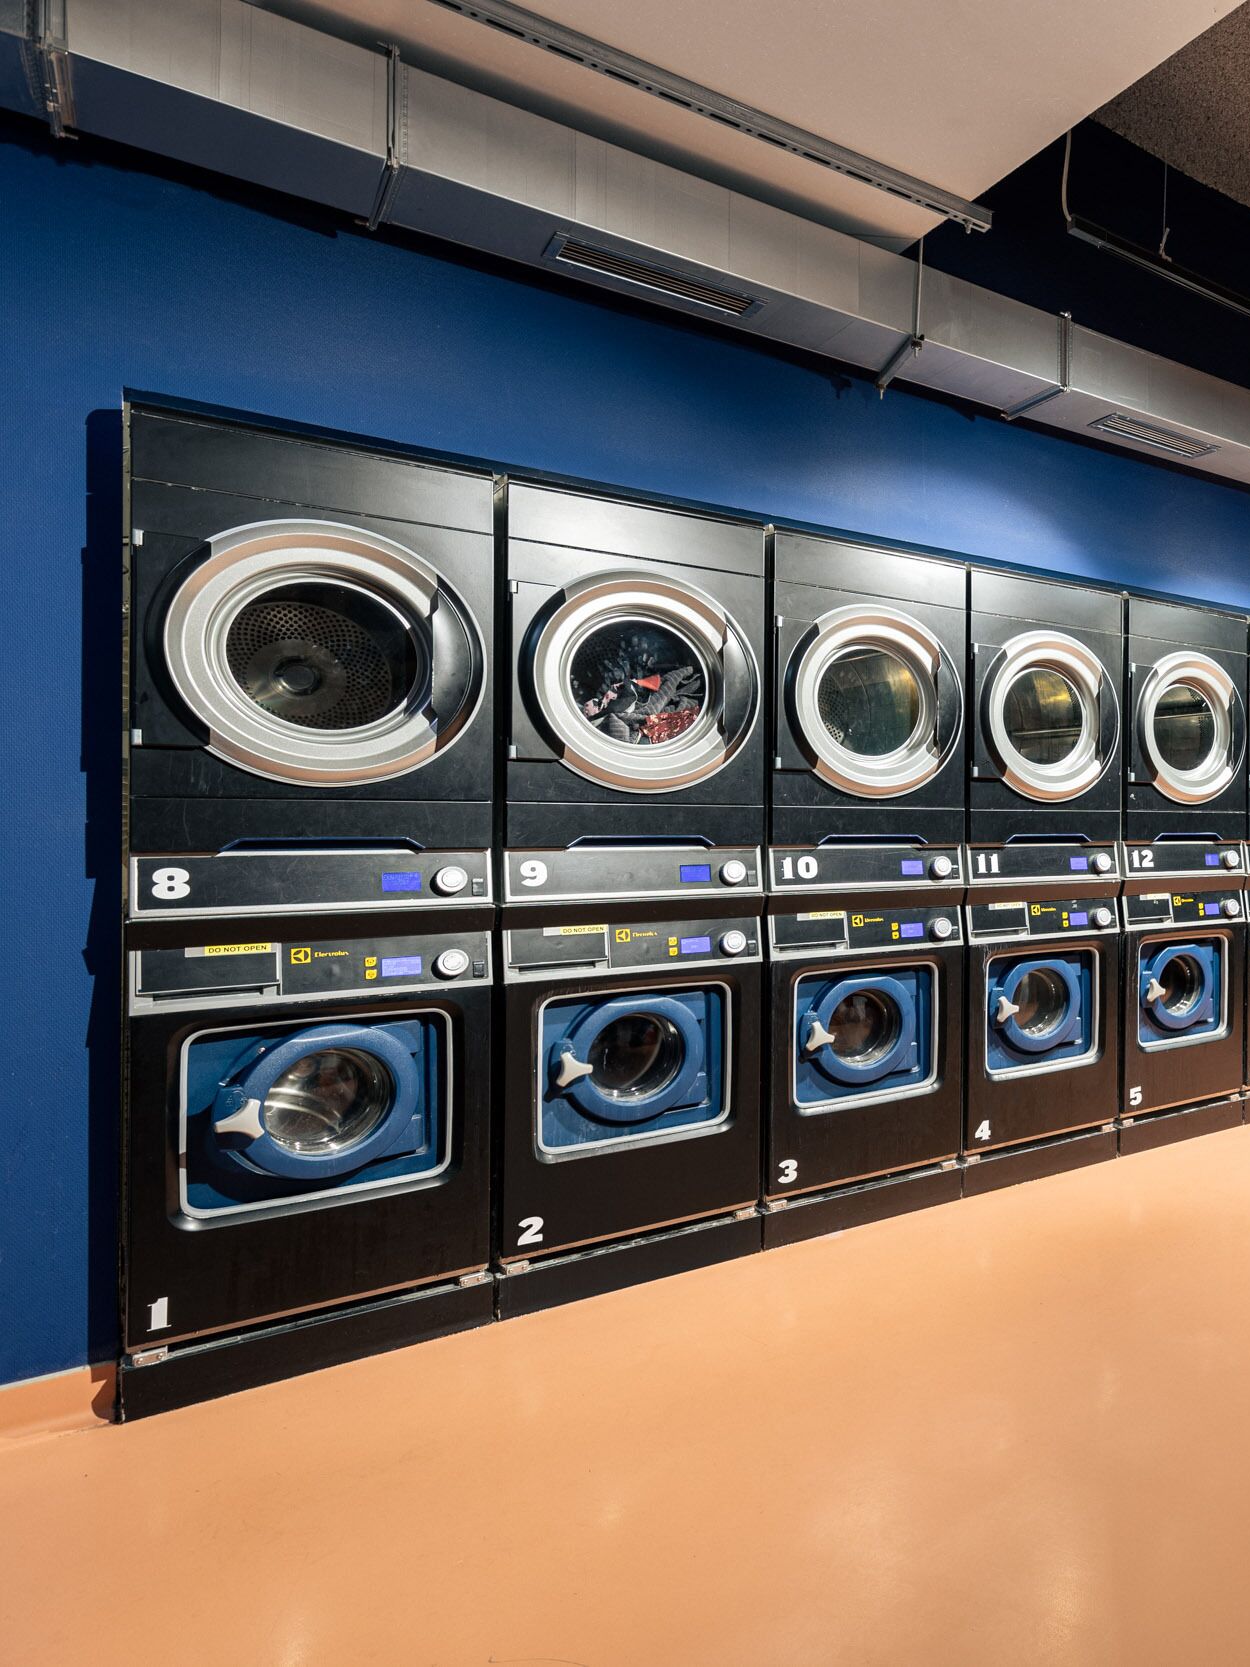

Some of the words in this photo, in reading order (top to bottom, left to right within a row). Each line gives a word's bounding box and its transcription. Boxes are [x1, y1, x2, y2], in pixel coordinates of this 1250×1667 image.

[780, 855, 818, 880] 10
[976, 853, 1001, 874] 11
[1131, 849, 1155, 868] 12
[151, 867, 191, 900] 8
[519, 859, 548, 888] 9
[243, 944, 267, 952] OPEN
[1129, 1086, 1143, 1106] 5
[974, 1119, 992, 1141] 4
[777, 1159, 798, 1184] 3
[517, 1216, 544, 1246] 2
[146, 1296, 172, 1333] 1
